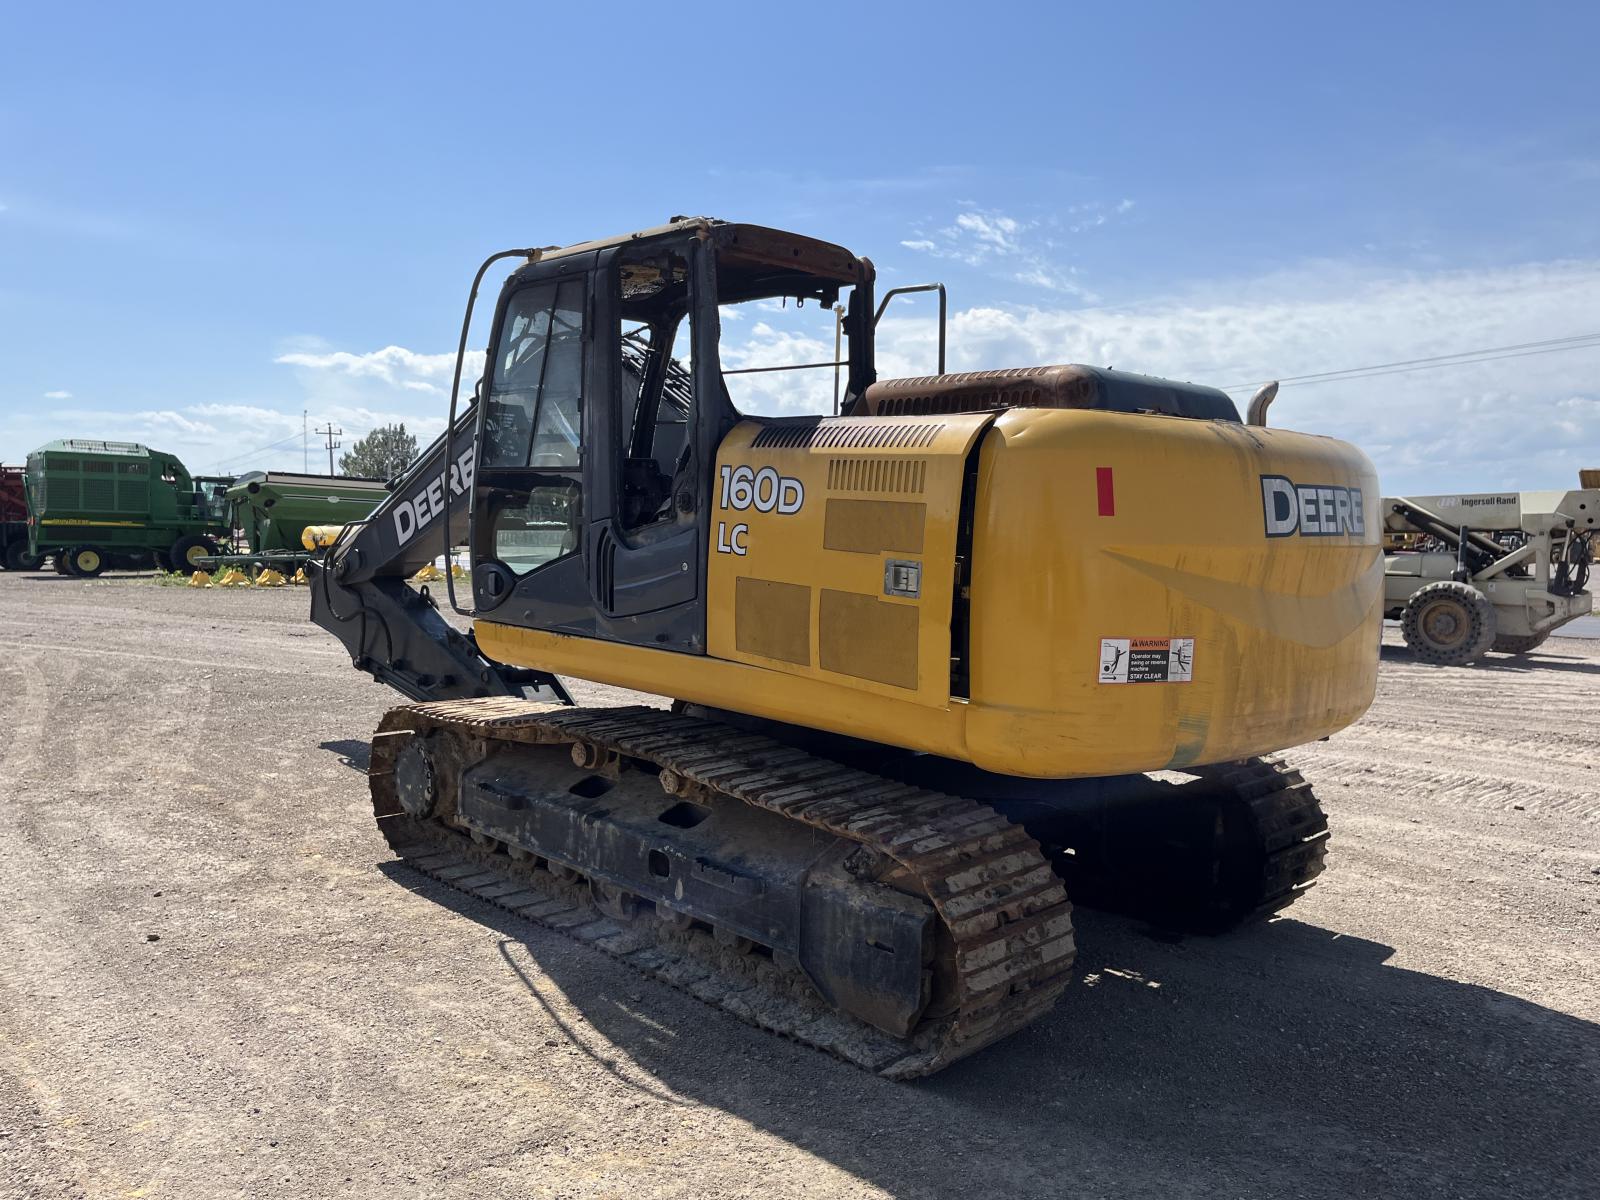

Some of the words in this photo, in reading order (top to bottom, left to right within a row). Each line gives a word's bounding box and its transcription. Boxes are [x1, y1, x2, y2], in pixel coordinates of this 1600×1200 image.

[392, 447, 475, 546] DEERE
[720, 464, 804, 515] 160D
[1260, 474, 1365, 538] DEERE
[1462, 497, 1495, 507] Ingersoll
[1496, 496, 1517, 505] Rand
[717, 522, 749, 555] LC
